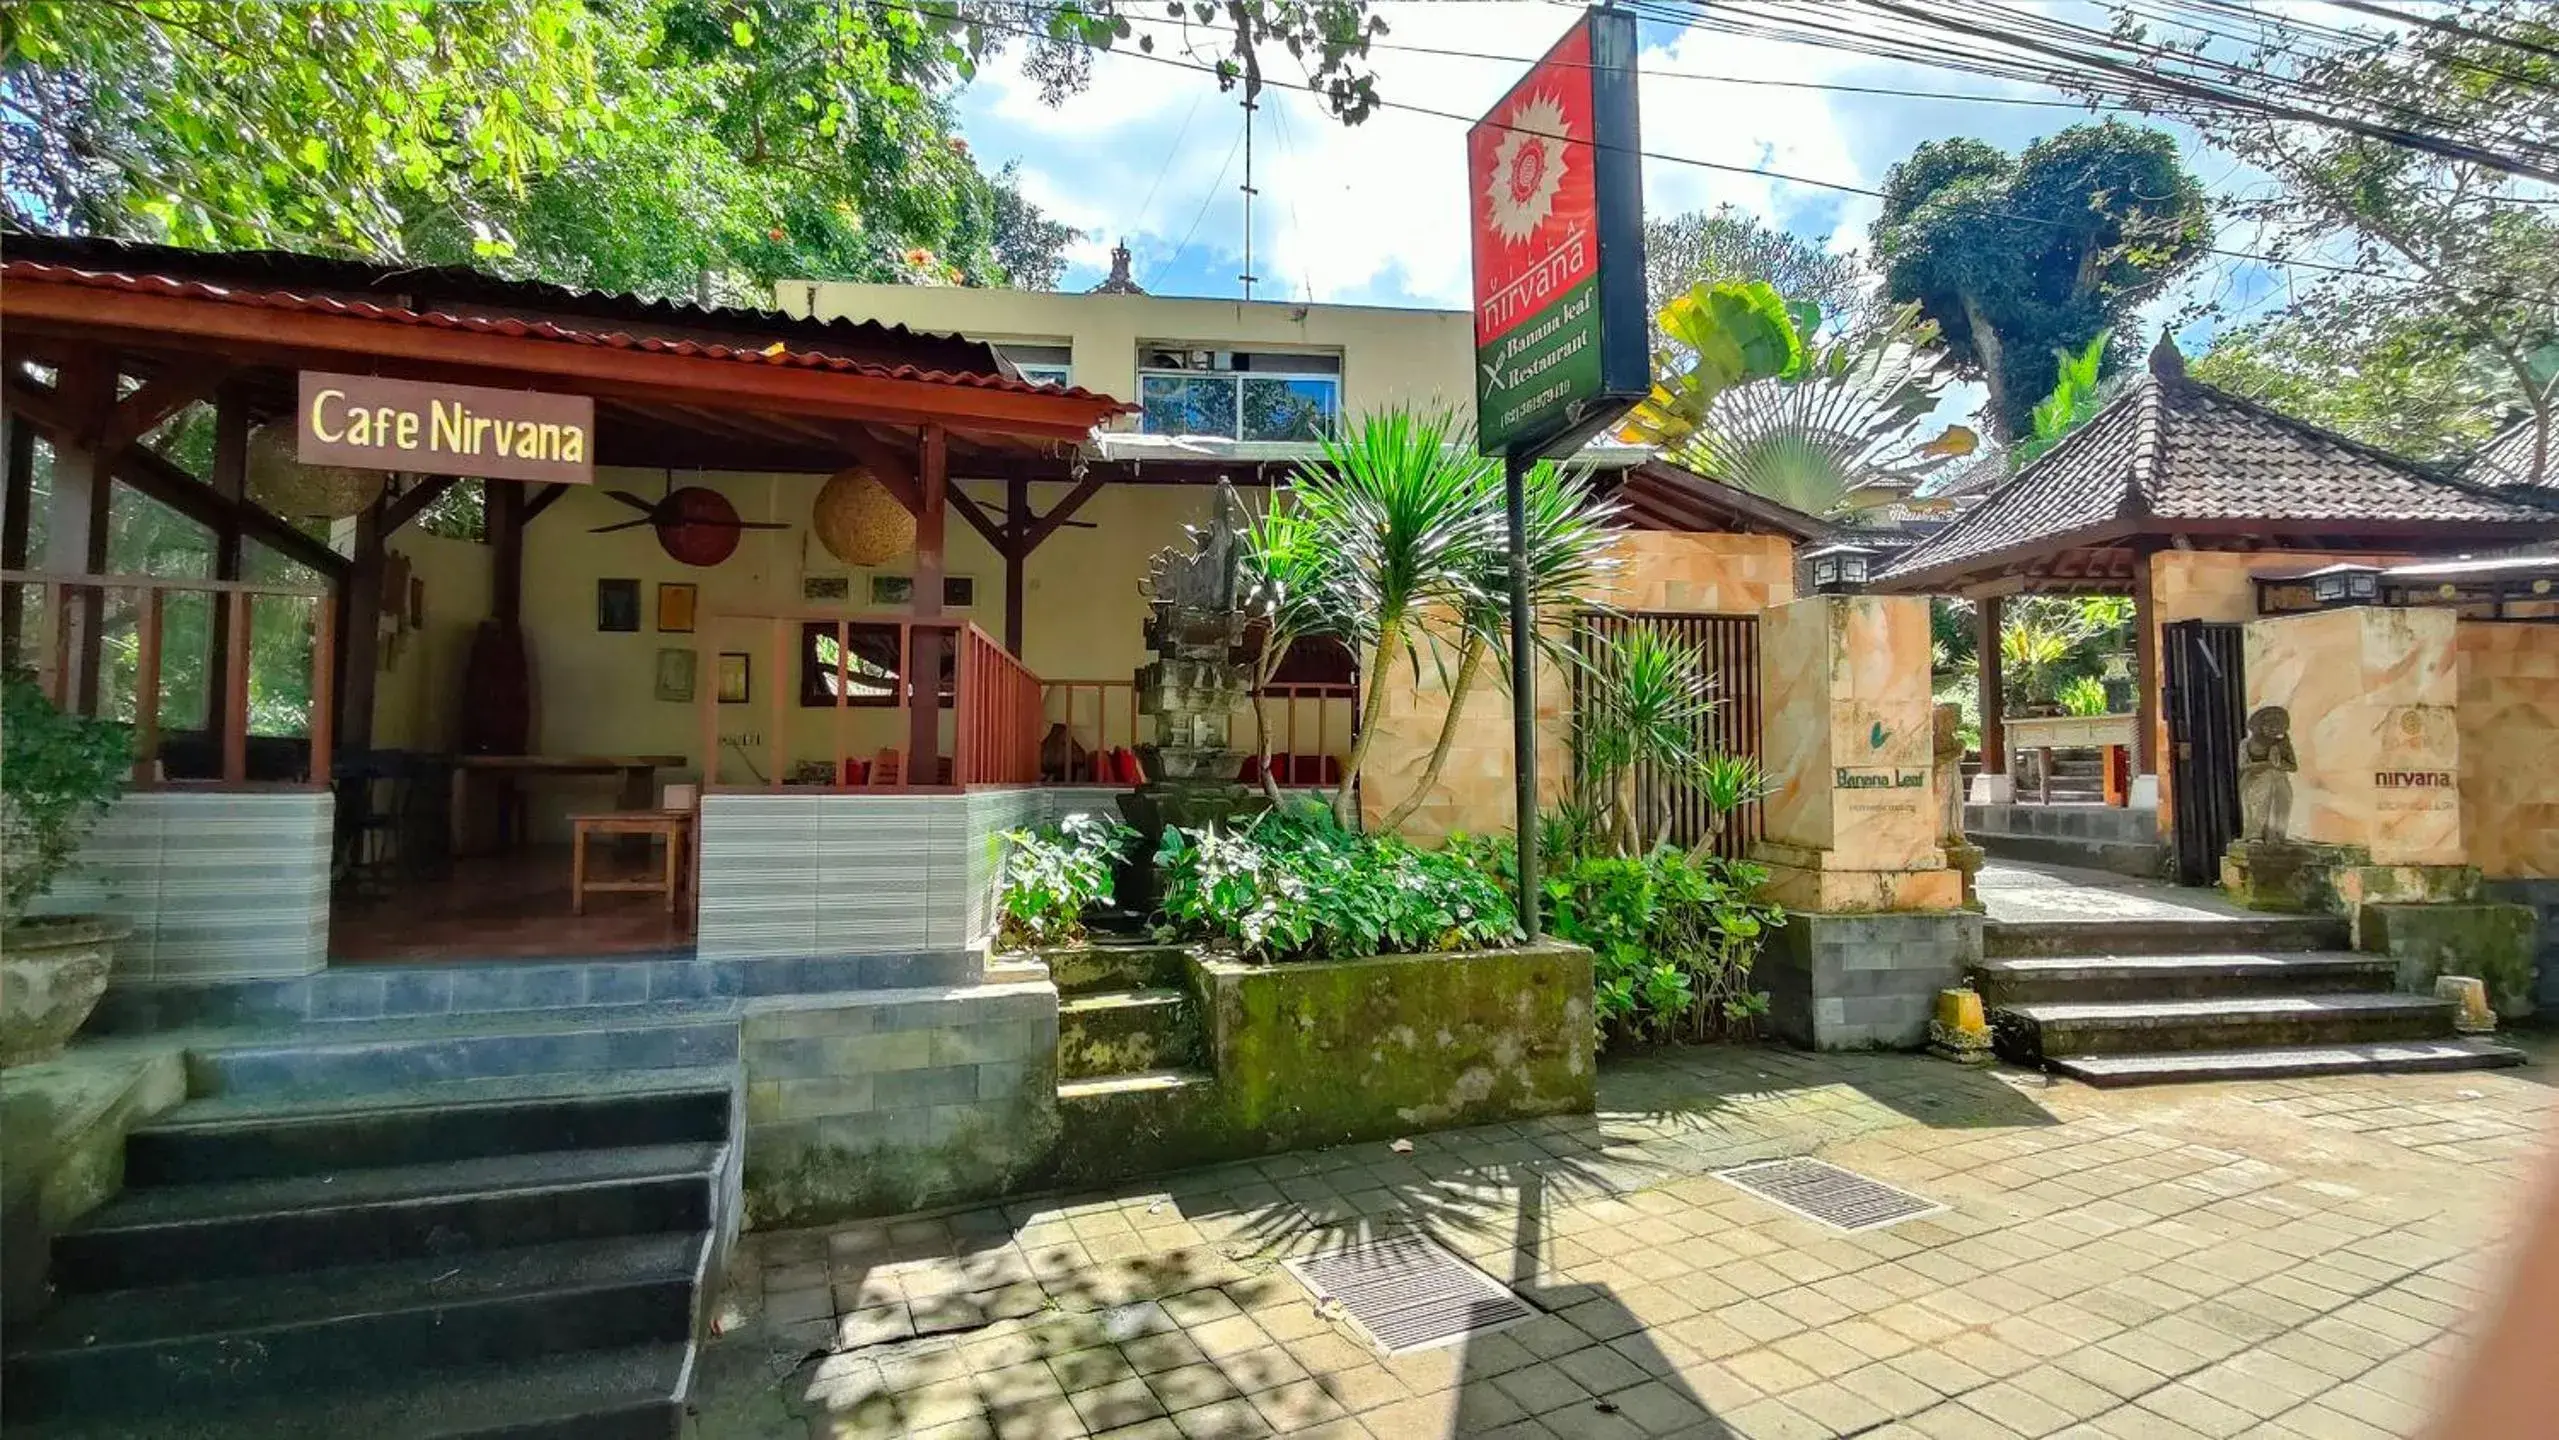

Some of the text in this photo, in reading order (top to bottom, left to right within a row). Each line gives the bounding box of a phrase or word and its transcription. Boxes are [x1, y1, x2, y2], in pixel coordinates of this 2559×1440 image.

[1484, 240, 1584, 333] nirvana
[1490, 219, 1575, 293] VILLA
[1506, 286, 1592, 359] Banana leaf
[1508, 327, 1588, 390] Restaurant
[311, 389, 585, 464] Cafe Nirvana
[1836, 767, 1925, 788] Banana Leaf
[2374, 771, 2451, 787] nirvana
